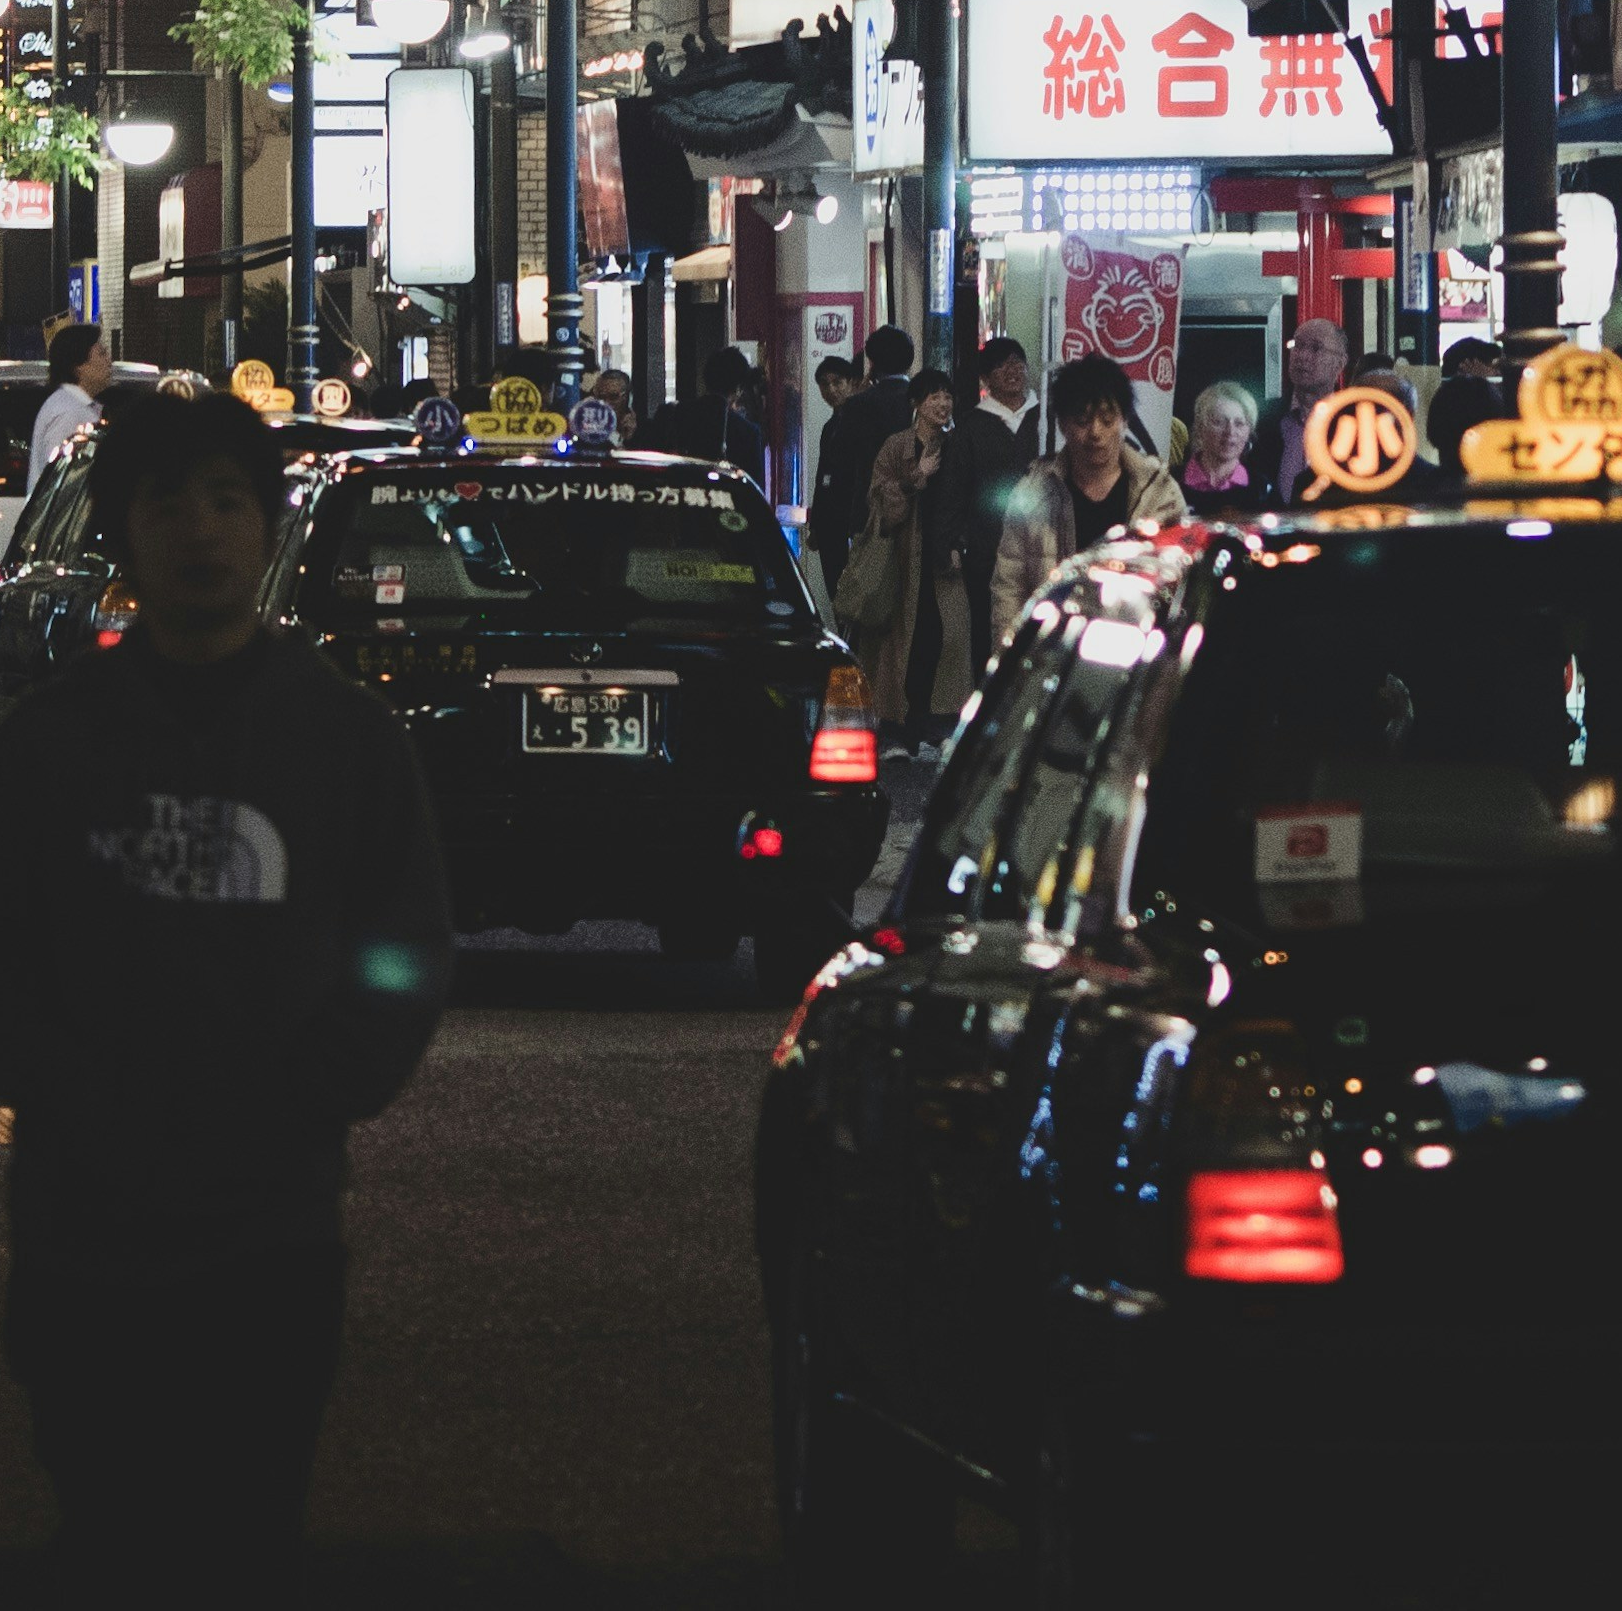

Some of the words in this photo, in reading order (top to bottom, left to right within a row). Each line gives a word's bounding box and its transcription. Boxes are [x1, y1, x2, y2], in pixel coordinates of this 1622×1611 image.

[425, 404, 453, 433] 小
[475, 416, 557, 438] つばめ
[1329, 399, 1405, 478] 小
[589, 696, 621, 714] 530
